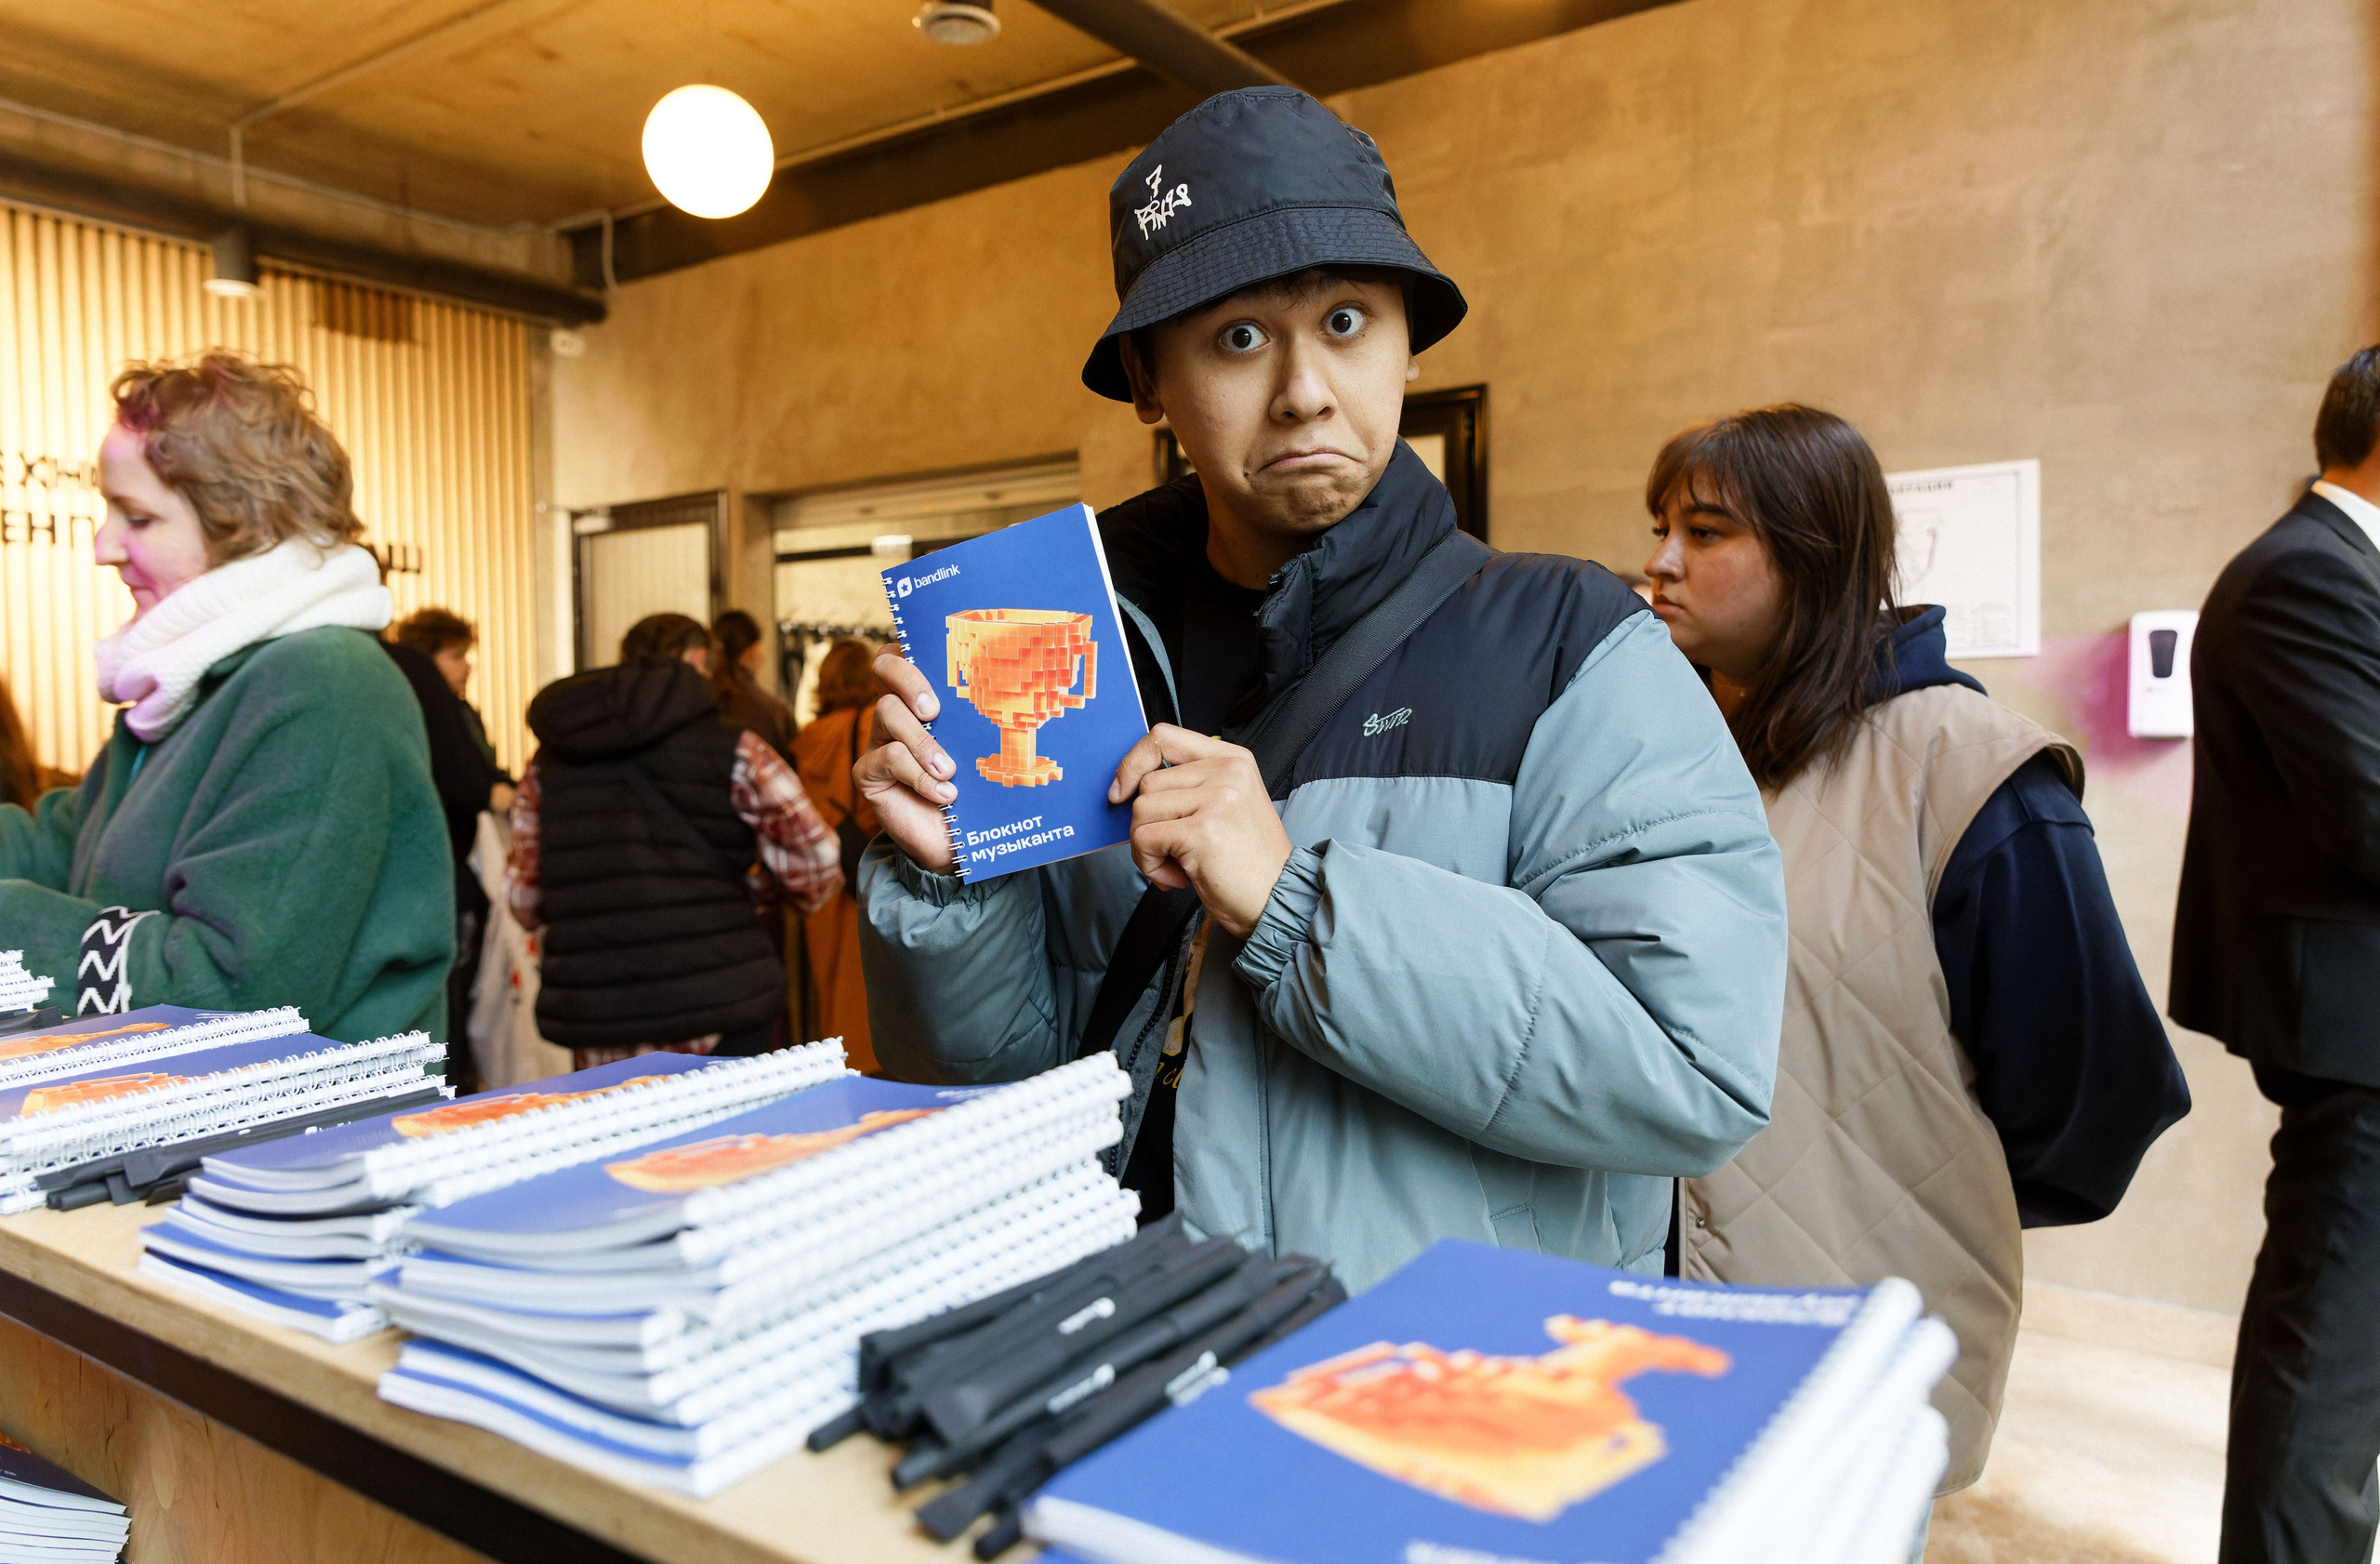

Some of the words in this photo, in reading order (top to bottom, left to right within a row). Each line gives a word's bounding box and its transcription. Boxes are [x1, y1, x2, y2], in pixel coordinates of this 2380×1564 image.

[914, 563, 961, 589] bandlink
[966, 815, 1042, 846] Блокнот
[971, 825, 1075, 862] музыканта
